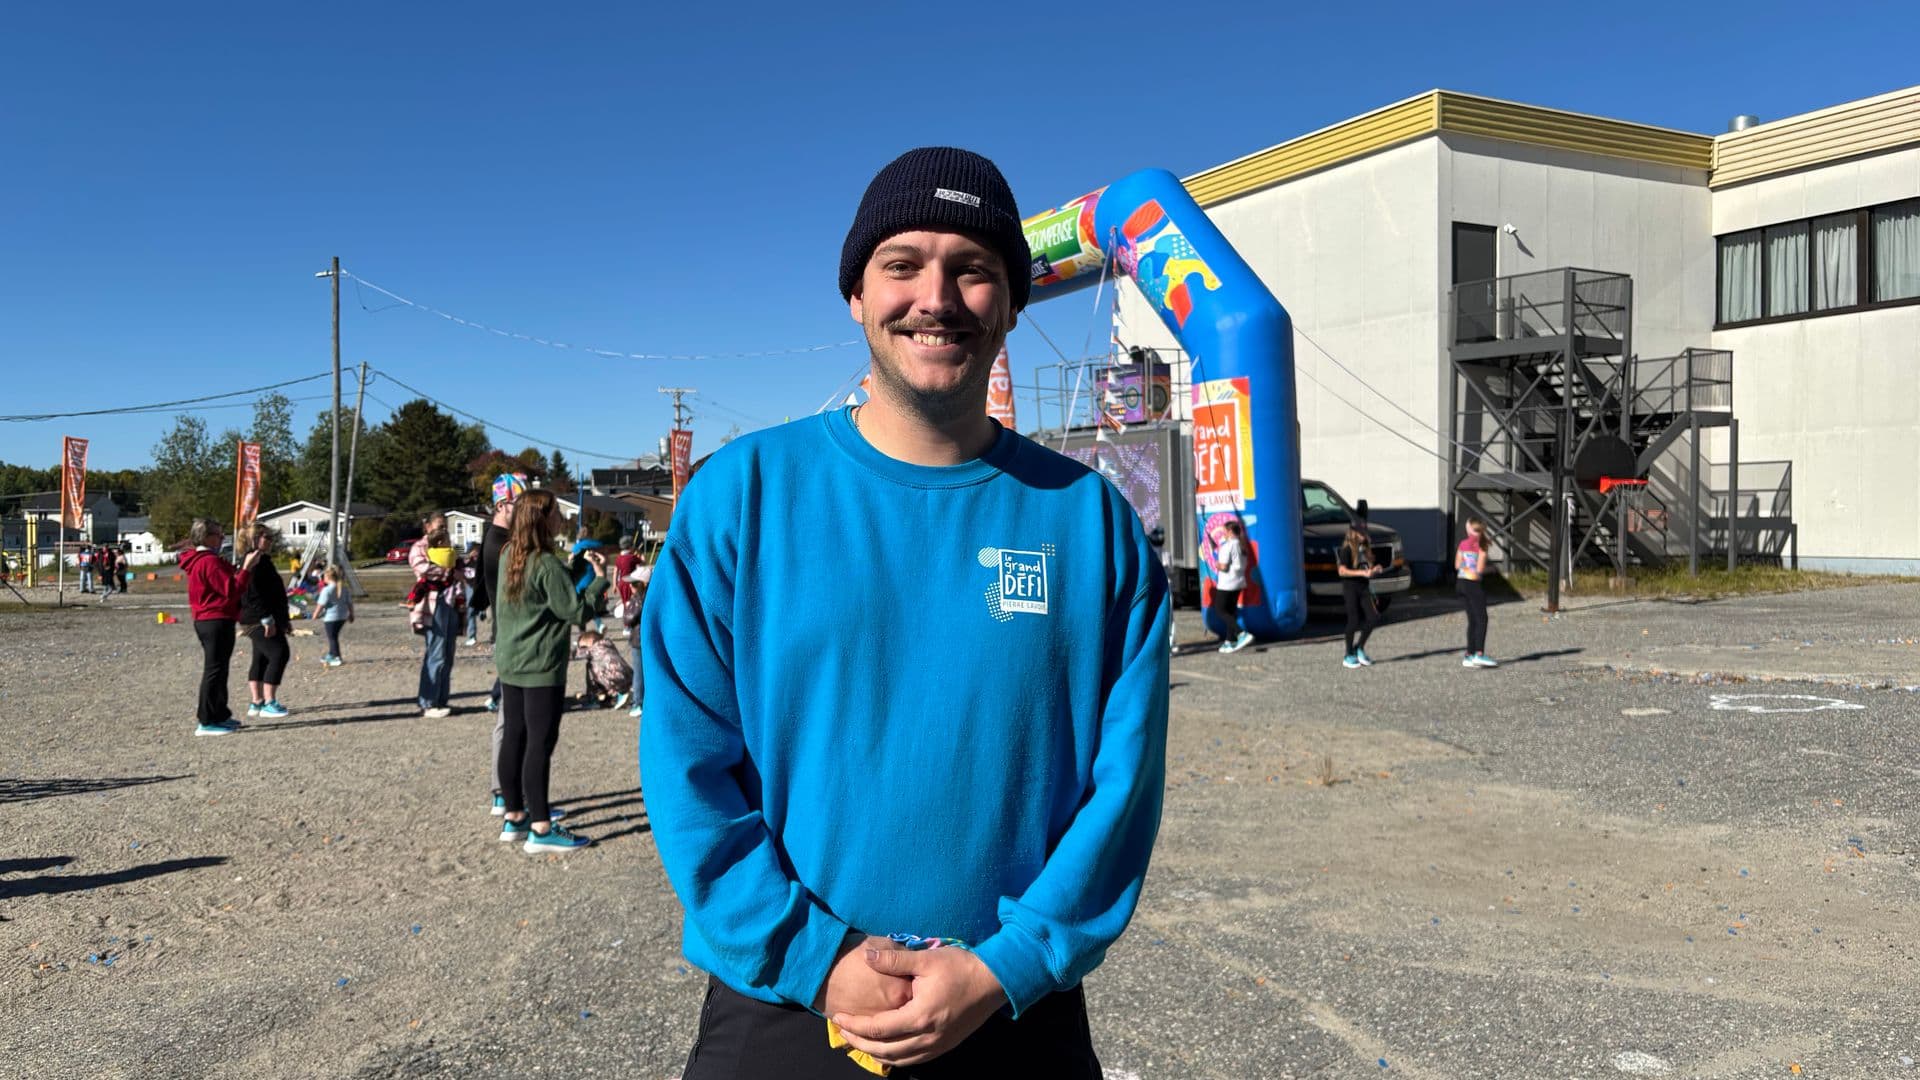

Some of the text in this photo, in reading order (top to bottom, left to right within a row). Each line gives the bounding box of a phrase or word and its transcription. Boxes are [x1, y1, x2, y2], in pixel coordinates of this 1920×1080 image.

[1194, 415, 1231, 440] rand
[1004, 553, 1012, 561] le
[1004, 560, 1041, 574] grand
[1002, 600, 1025, 609] PIERRE
